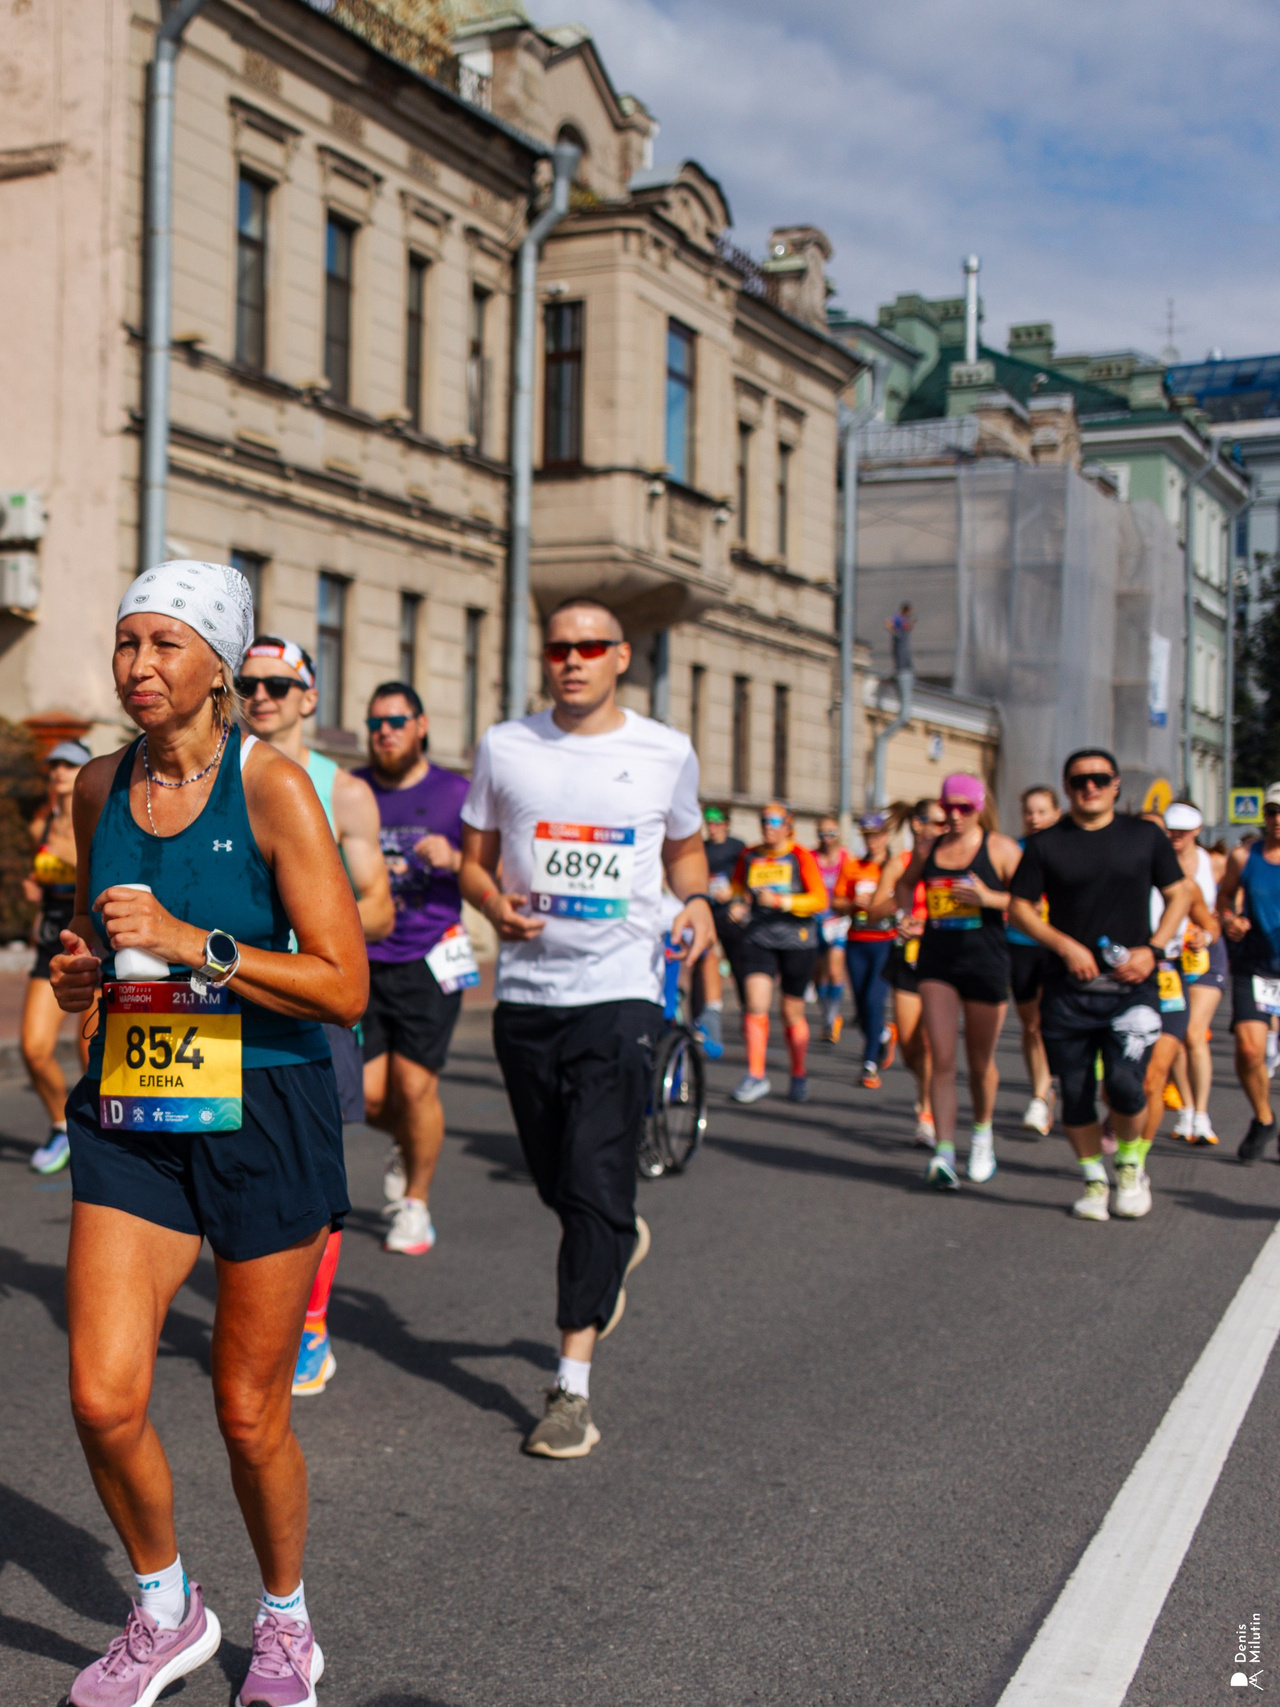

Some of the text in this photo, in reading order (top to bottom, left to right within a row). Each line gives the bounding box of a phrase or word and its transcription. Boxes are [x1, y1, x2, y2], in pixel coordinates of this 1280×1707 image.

[546, 848, 620, 882] 6894
[119, 994, 152, 1003] МАРАФОН
[172, 992, 195, 1005] 21,1
[126, 1025, 204, 1070] 854
[139, 1075, 184, 1087] ЕЛЕНА
[110, 1100, 123, 1123] D
